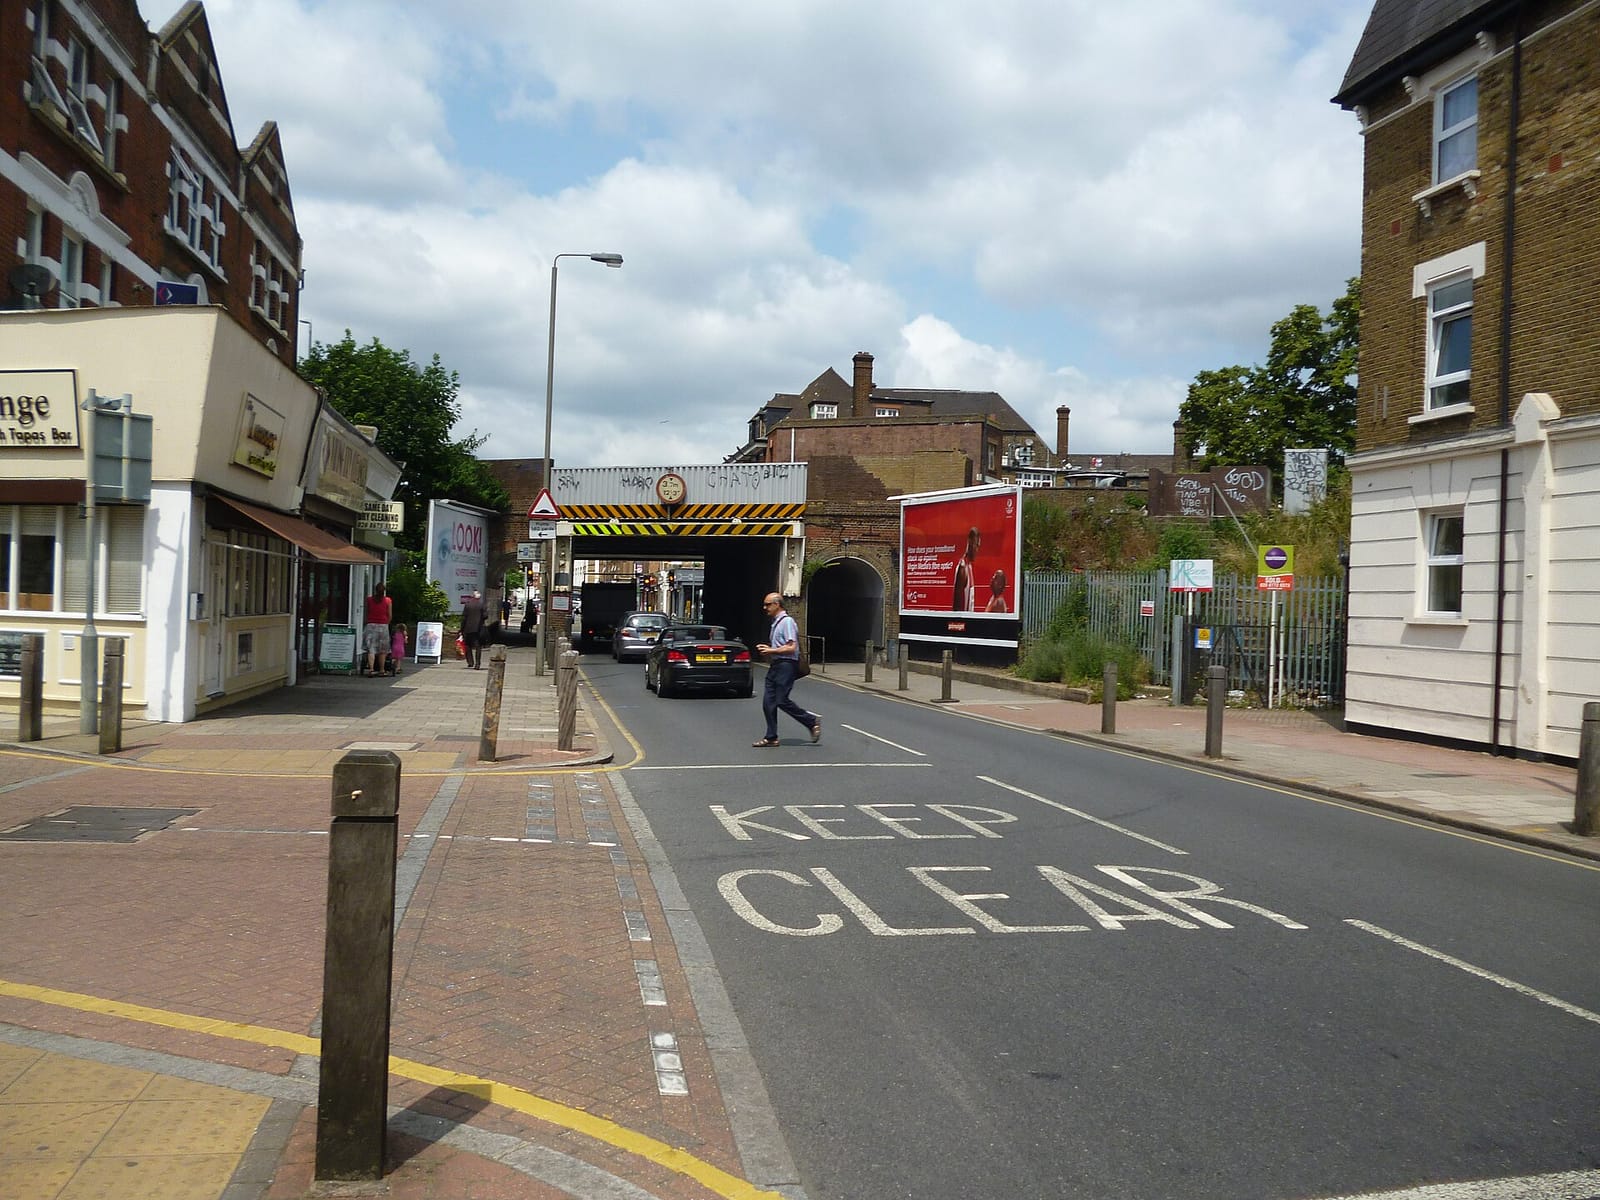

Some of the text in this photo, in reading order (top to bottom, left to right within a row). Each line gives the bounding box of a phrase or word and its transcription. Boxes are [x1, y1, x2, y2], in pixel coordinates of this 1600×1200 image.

[8, 428, 46, 443] Tapas
[51, 428, 73, 440] Bar
[364, 503, 393, 512] SAME DAY
[370, 513, 399, 523] CLEANING
[452, 521, 482, 554] LOOK!
[708, 803, 1018, 841] KEEP
[716, 864, 1309, 936] CLEAR
